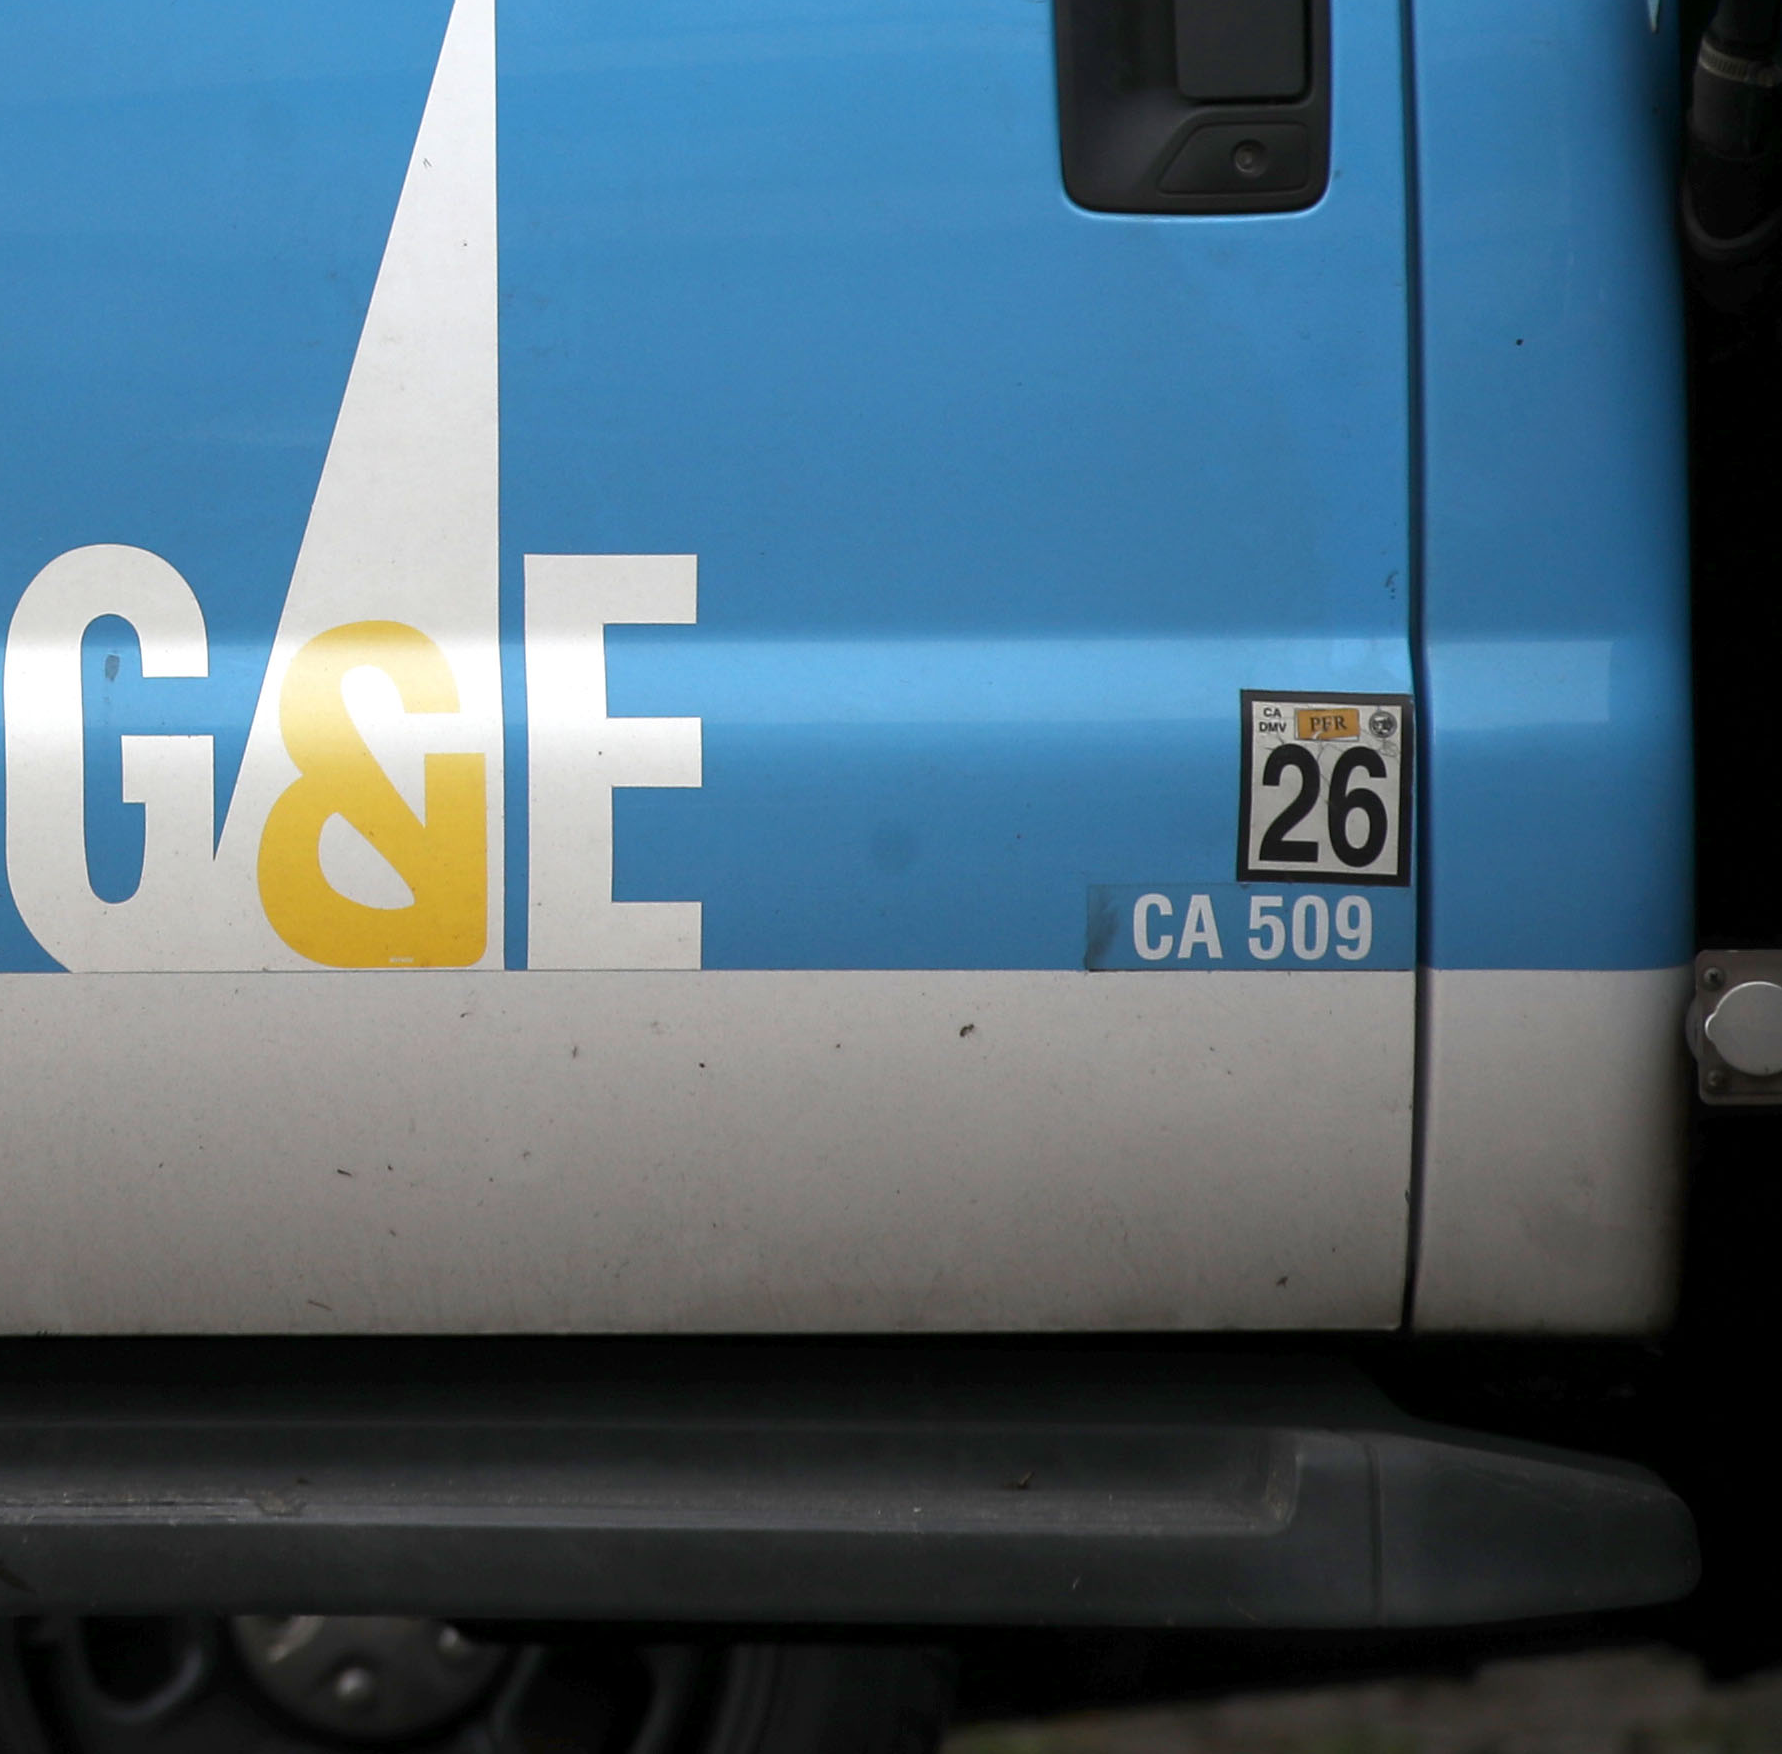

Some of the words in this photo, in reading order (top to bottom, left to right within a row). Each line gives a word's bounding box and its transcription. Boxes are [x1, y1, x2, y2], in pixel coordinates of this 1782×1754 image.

[1259, 721, 1287, 733] DMV
[1263, 707, 1282, 718] CA
[1259, 743, 1389, 868] 26
[1133, 893, 1224, 961] CA
[1248, 894, 1373, 961] 509
